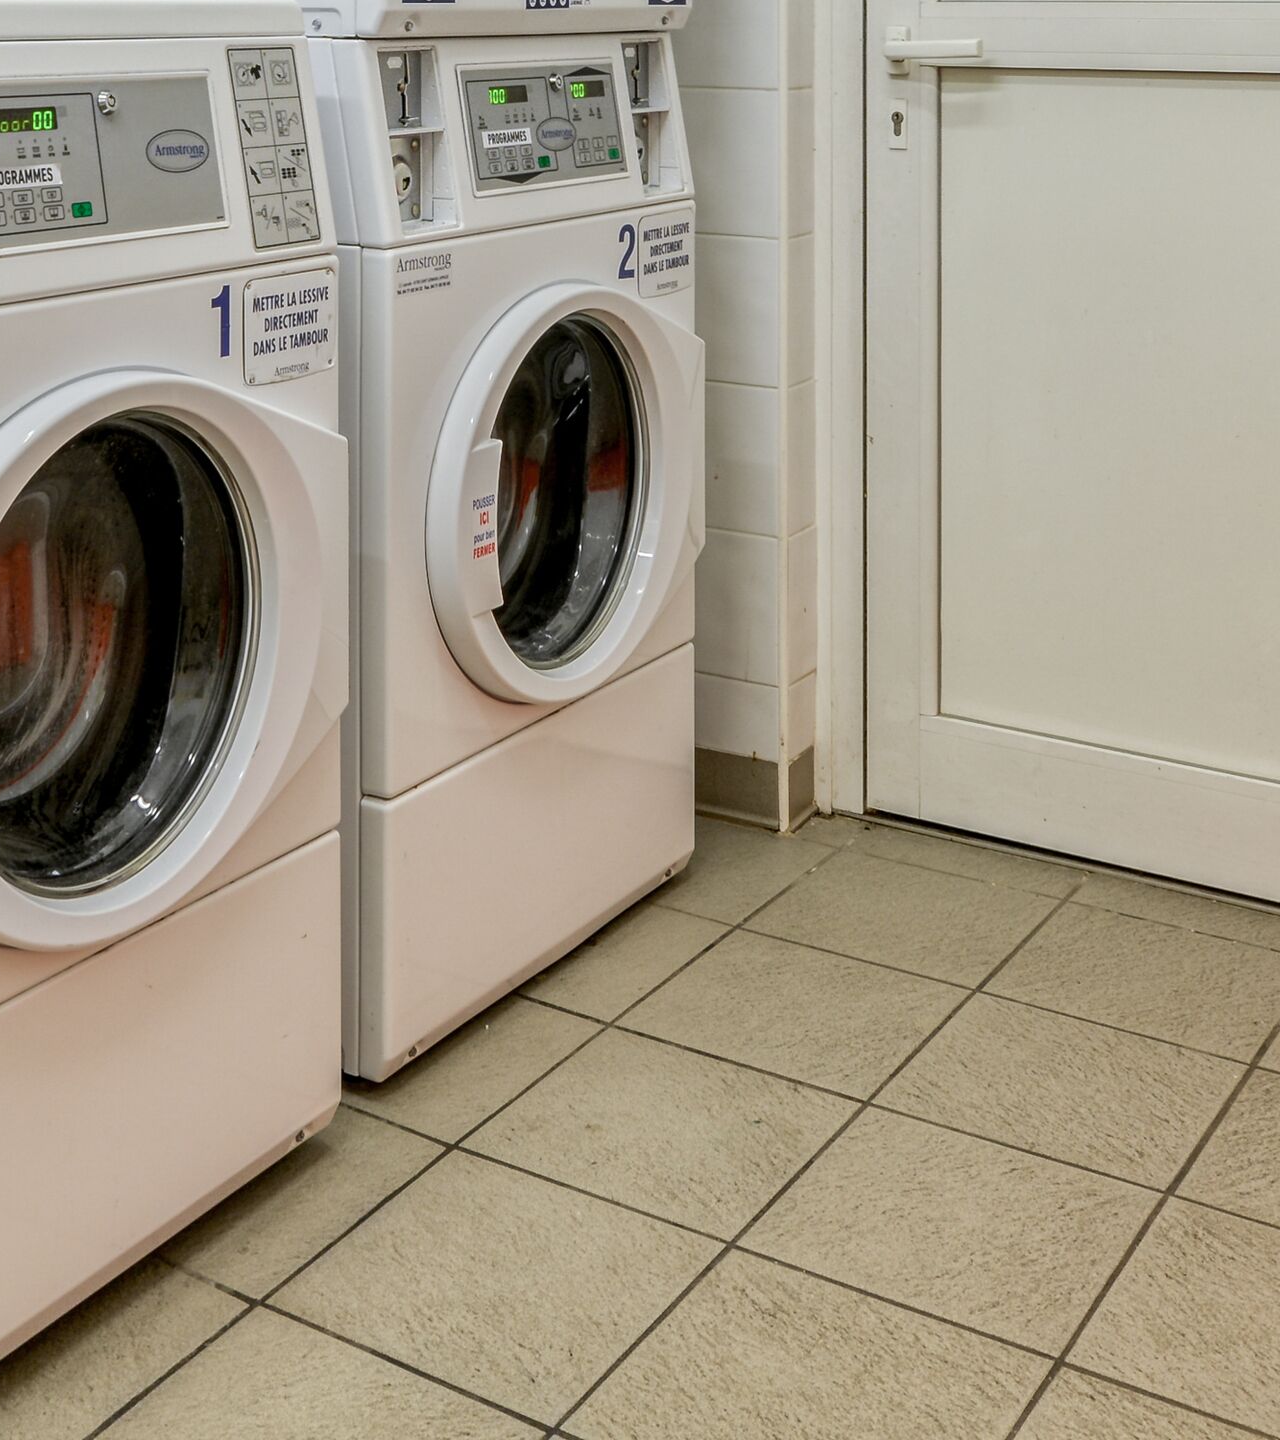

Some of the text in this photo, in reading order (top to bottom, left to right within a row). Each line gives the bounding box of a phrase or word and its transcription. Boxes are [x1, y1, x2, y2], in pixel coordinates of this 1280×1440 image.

[487, 131, 528, 145] PROGRAMMES
[155, 144, 205, 157] Armstrong
[643, 222, 690, 242] METTRE LA LESSIVE
[618, 224, 636, 280] 2
[650, 240, 683, 257] DIRECTEMENT
[396, 253, 452, 274] Armstrong
[643, 262, 657, 275] DANS
[665, 255, 690, 271] TAMBOUR
[253, 286, 329, 313] METTRE LA LESSIVE
[211, 285, 230, 357] 1
[264, 309, 318, 333] DIRECTEMENT
[253, 328, 329, 357] DANS LE TAMBOUR
[274, 361, 310, 376] Armstrong
[473, 494, 495, 510] POUSSER
[480, 511, 489, 525] ICI
[473, 542, 495, 560] FERMER
